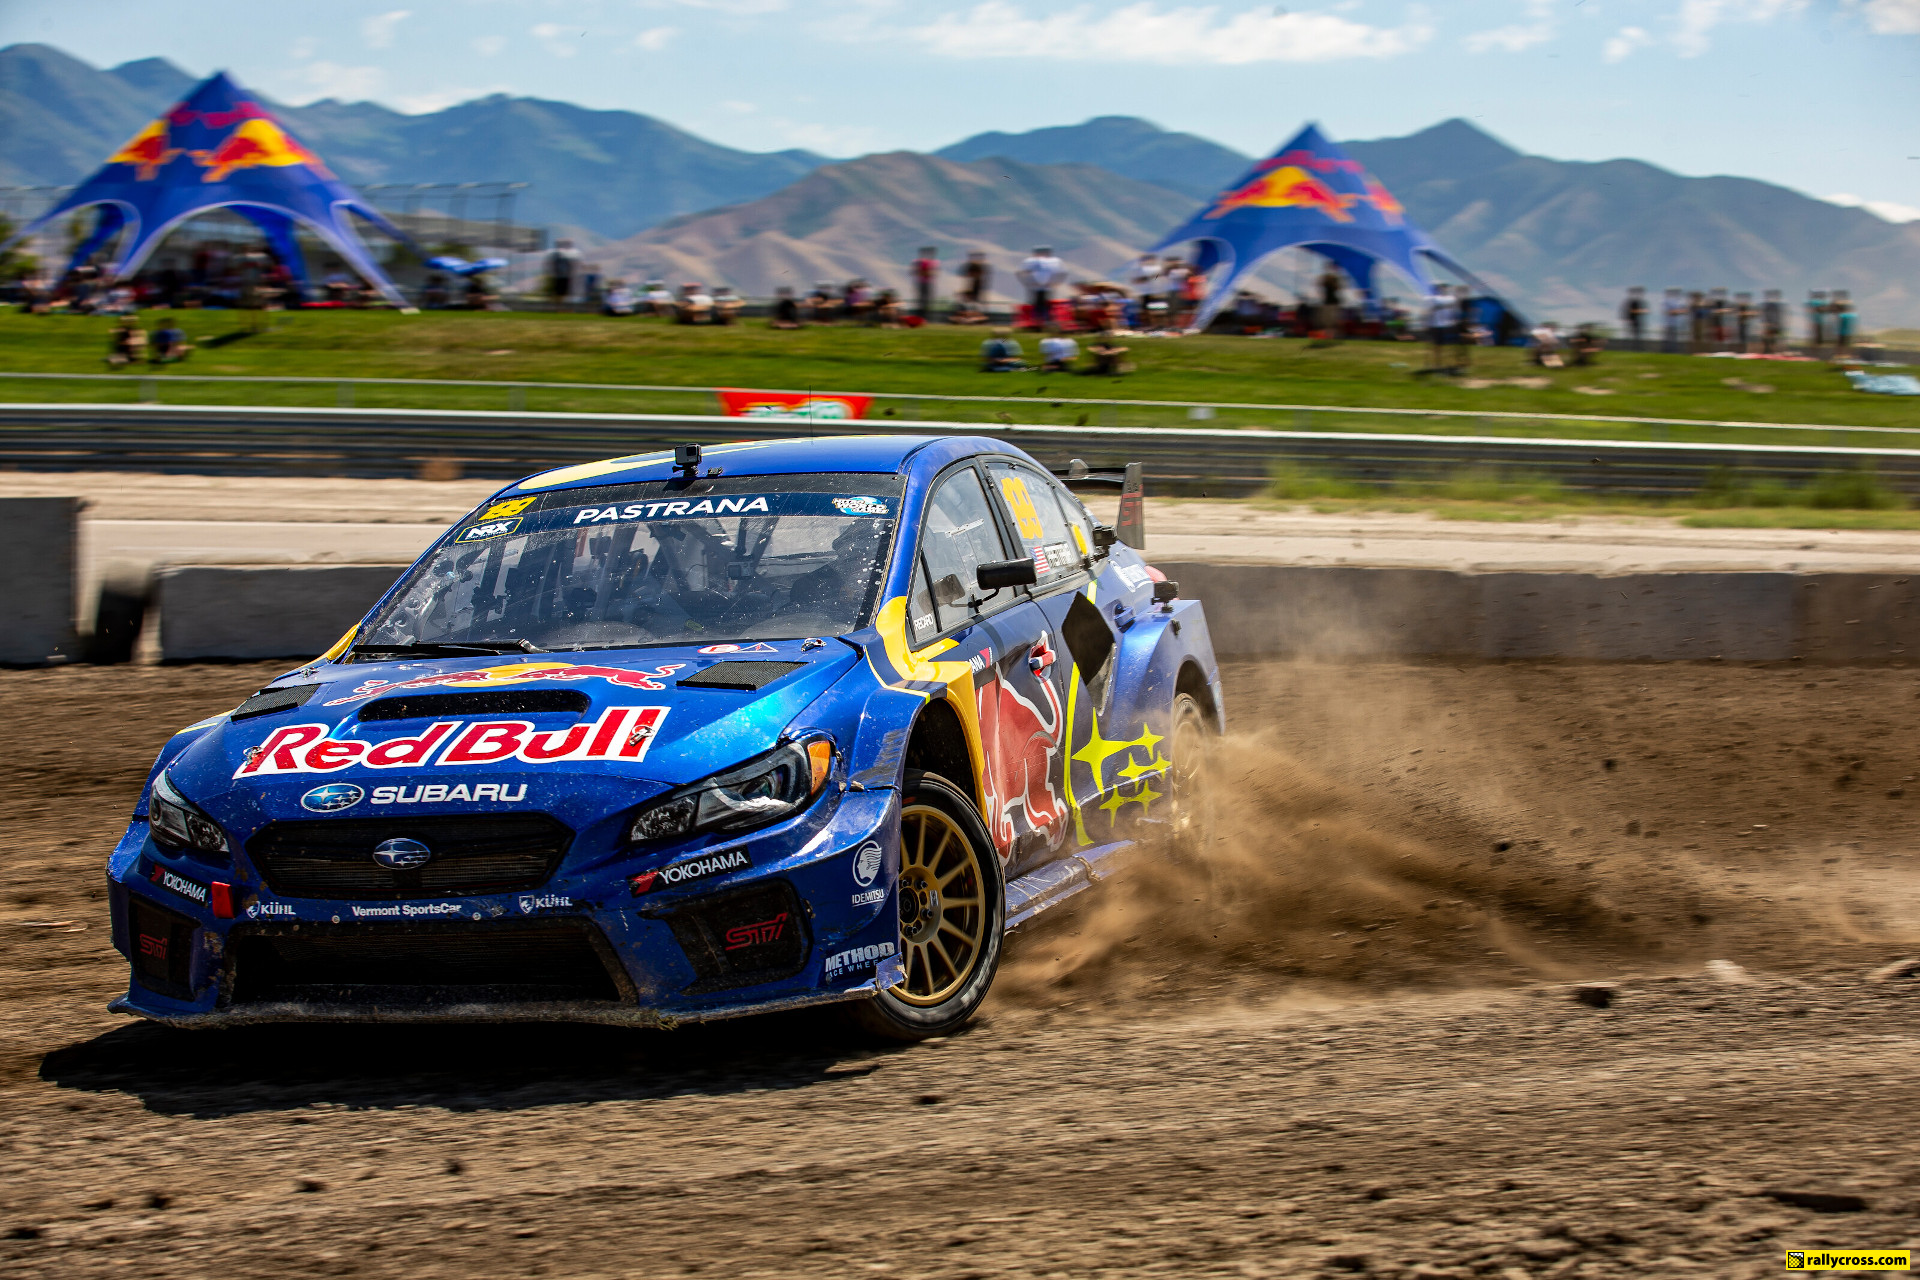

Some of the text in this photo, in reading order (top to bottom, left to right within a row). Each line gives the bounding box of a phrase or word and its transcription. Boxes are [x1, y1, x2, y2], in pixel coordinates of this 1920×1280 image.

[573, 496, 769, 524] PASTRANA
[465, 520, 514, 539] NRX
[233, 706, 671, 778] Red Bull
[370, 783, 528, 804] SUBARU
[659, 850, 748, 885] YOKOHAMA
[163, 871, 207, 902] YOKOHAMA
[851, 889, 885, 904] IDEMITSU
[261, 902, 296, 915] KÜHL
[352, 902, 462, 918] Vermont SportsCar
[535, 895, 573, 909] KÜHL
[825, 941, 895, 972] METHOD
